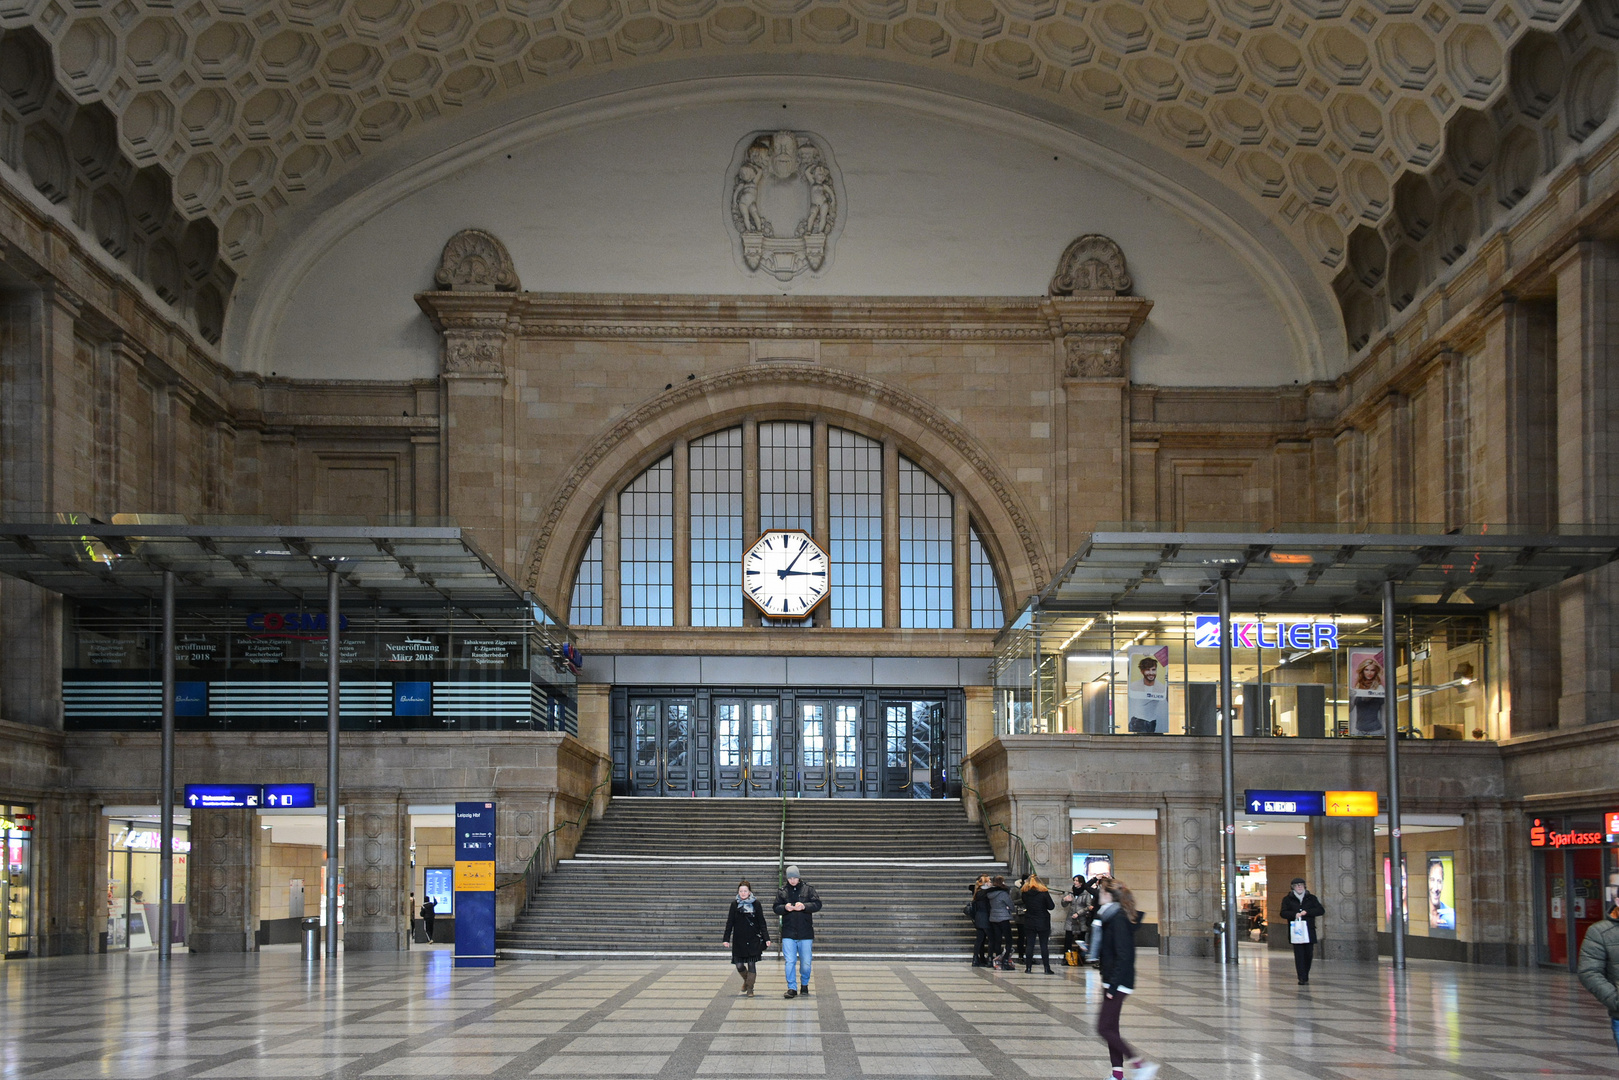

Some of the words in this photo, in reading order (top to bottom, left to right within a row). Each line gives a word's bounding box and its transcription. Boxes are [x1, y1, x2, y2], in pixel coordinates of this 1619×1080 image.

[1231, 622, 1338, 650] KLIER
[385, 644, 440, 652] Neueröffnung
[1549, 829, 1602, 848] Sparkasse
